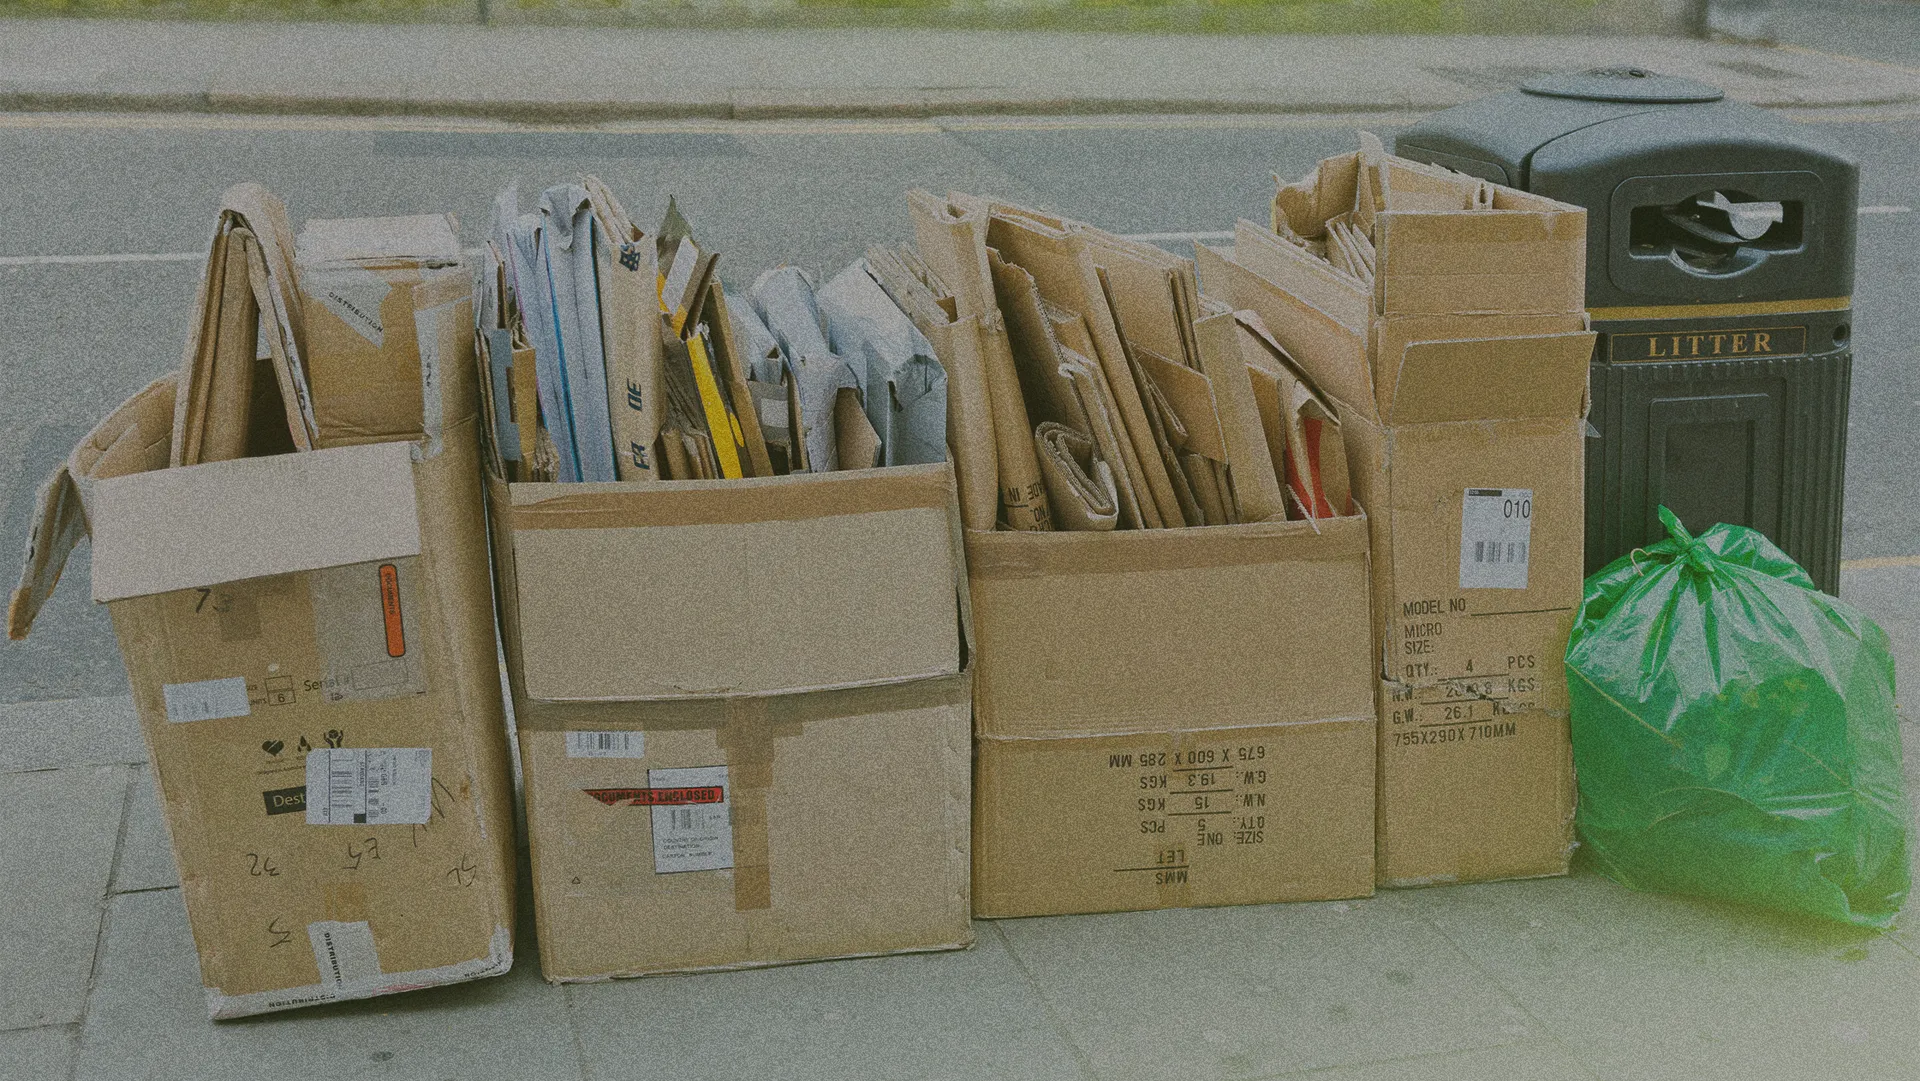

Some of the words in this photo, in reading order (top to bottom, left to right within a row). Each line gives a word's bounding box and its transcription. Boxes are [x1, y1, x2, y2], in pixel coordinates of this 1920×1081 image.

[1648, 330, 1773, 358] LITTER
[1503, 498, 1531, 518] 010
[1403, 600, 1445, 617] MODEL
[1449, 598, 1466, 612] NO
[1404, 622, 1442, 638] MICRO
[1404, 640, 1434, 655] SIZE:
[1465, 658, 1474, 673] 4
[1507, 655, 1536, 669] PCS
[1507, 678, 1536, 693] KGS
[277, 693, 285, 703] 6
[1444, 705, 1473, 720] 26.1
[1108, 753, 1132, 768] MM
[1139, 752, 1166, 767] 285
[1173, 751, 1182, 765] X
[1187, 750, 1215, 764] 600
[1221, 748, 1230, 763] X
[1238, 745, 1265, 761] 675
[1139, 774, 1168, 789] KGS
[1187, 772, 1216, 787] 19.3
[657, 788, 716, 802] ENCLOSED
[1193, 795, 1210, 810] 15
[1137, 797, 1166, 811] KGS
[1140, 820, 1166, 834] PCS
[1197, 818, 1207, 832] 5
[1196, 832, 1224, 846] ONE
[1232, 830, 1265, 845] SIZE:
[1154, 871, 1188, 885] MMS
